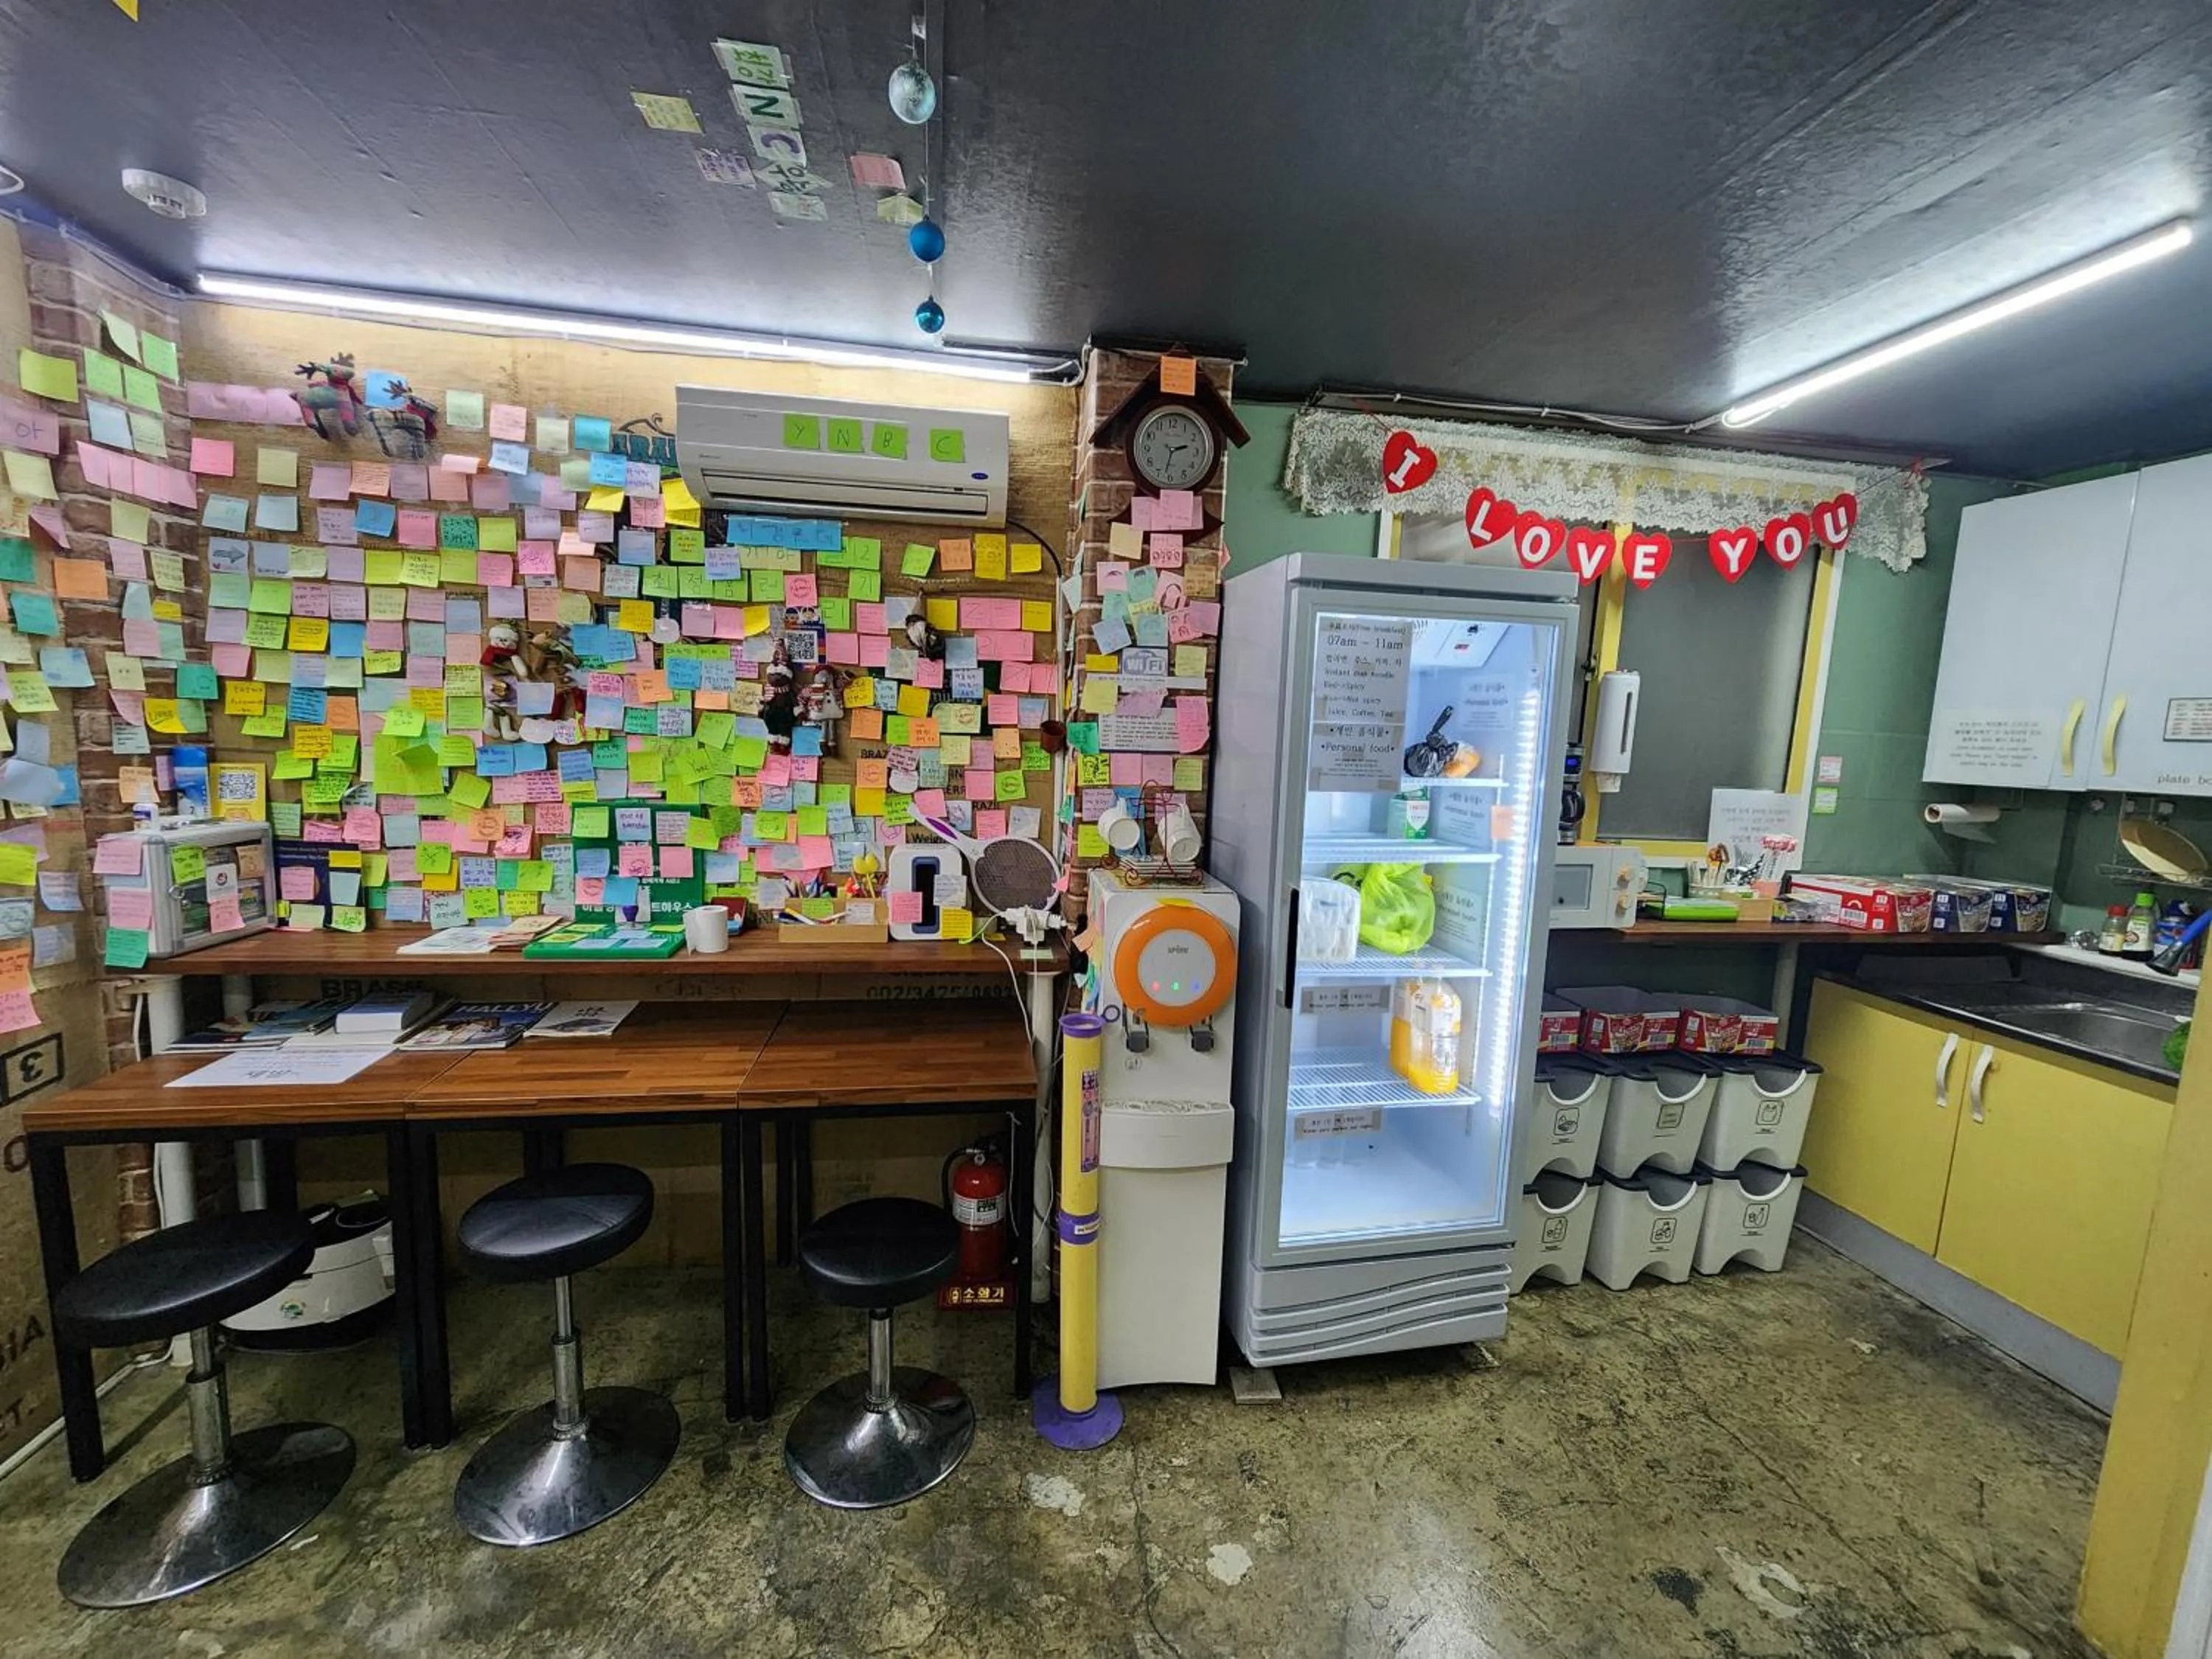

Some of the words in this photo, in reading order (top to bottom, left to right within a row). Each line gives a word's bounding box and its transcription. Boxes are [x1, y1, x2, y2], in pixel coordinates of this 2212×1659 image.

[1169, 419, 1178, 428] 12
[1191, 434, 1197, 442] 2
[1192, 448, 1199, 457] 3
[1389, 448, 1420, 488] I
[1181, 470, 1187, 479] 5
[1470, 501, 1658, 579] LOVE
[1722, 507, 1848, 573] YOU
[1327, 635, 1357, 647] 07am
[1376, 639, 1404, 650] 11am
[963, 1287, 1004, 1298] 소화기
